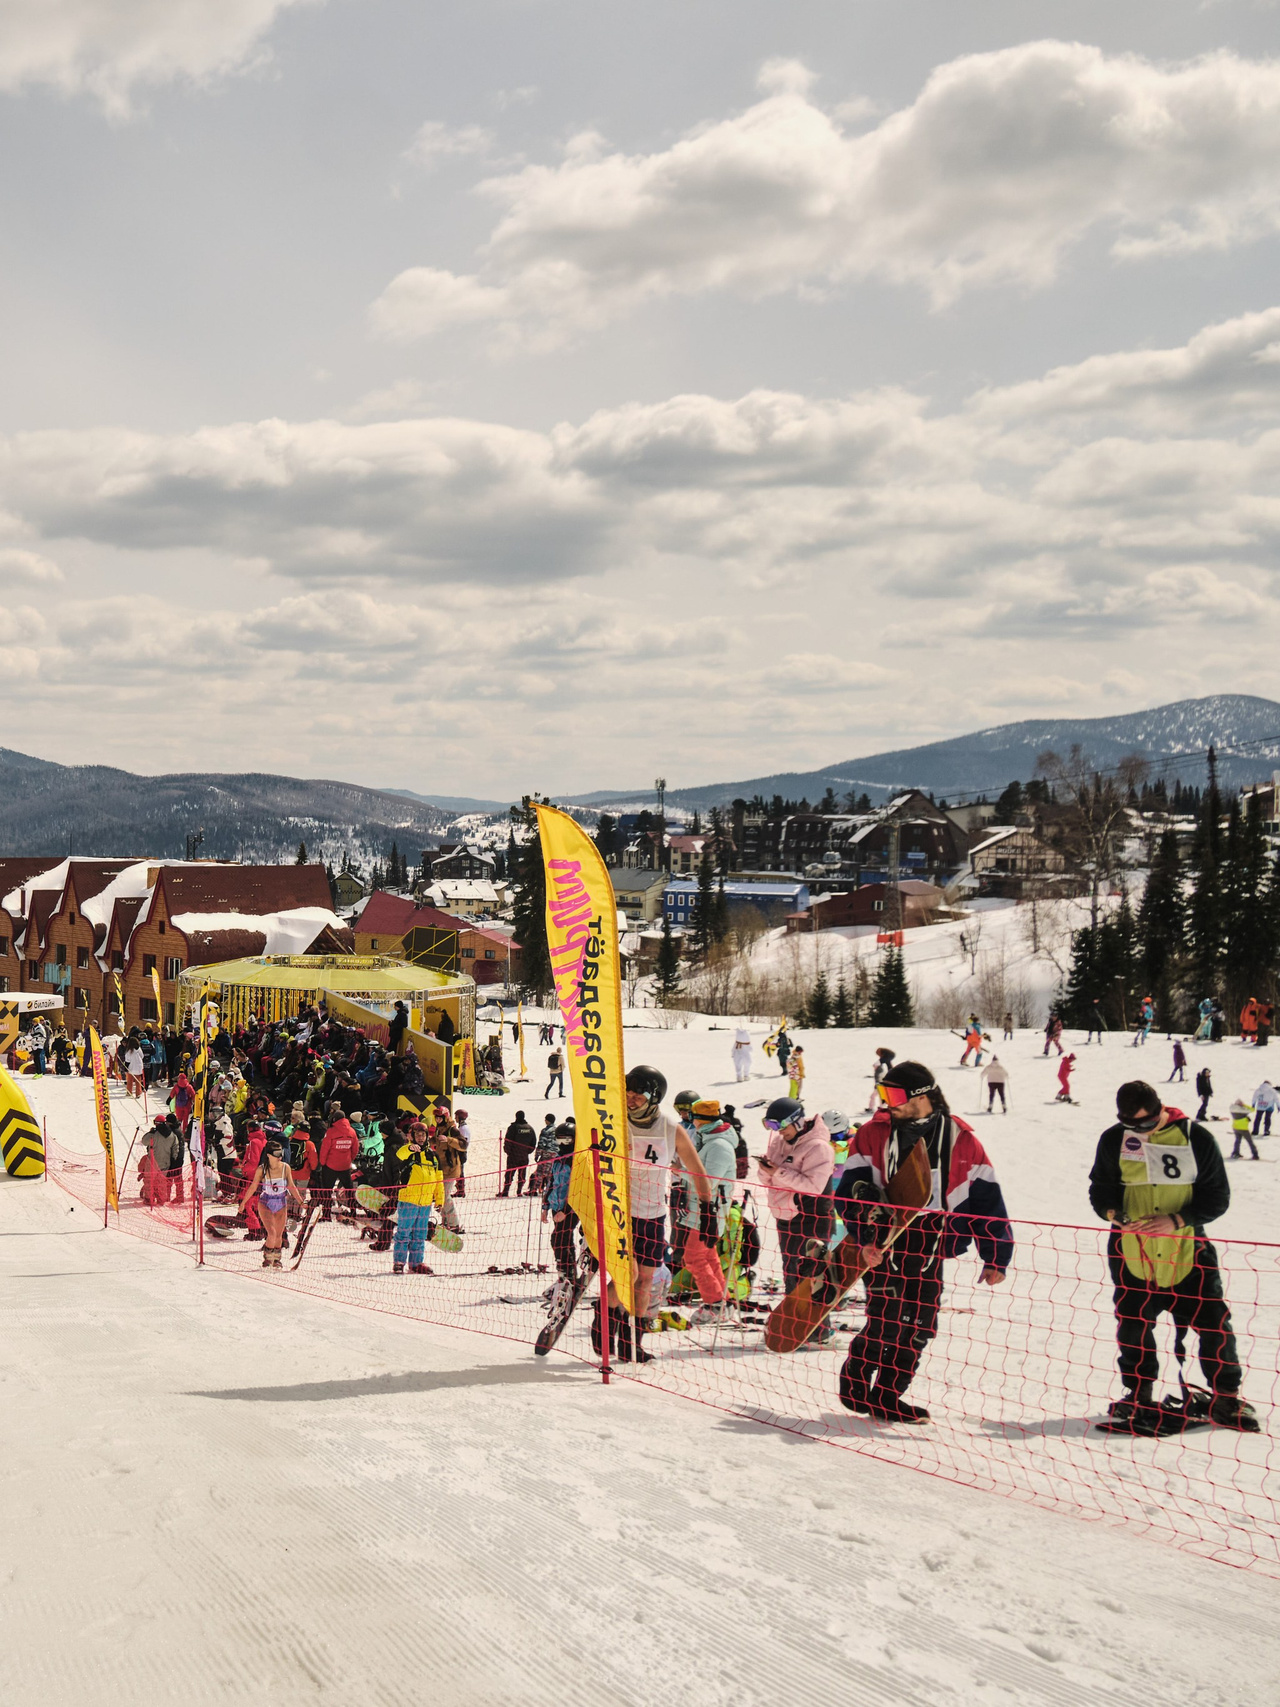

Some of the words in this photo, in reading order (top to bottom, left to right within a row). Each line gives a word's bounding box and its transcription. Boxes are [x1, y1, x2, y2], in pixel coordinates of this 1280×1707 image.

[33, 999, 56, 1009] билайн
[644, 1144, 659, 1164] 4
[1161, 1153, 1182, 1179] 8
[272, 1182, 279, 1192] 6
